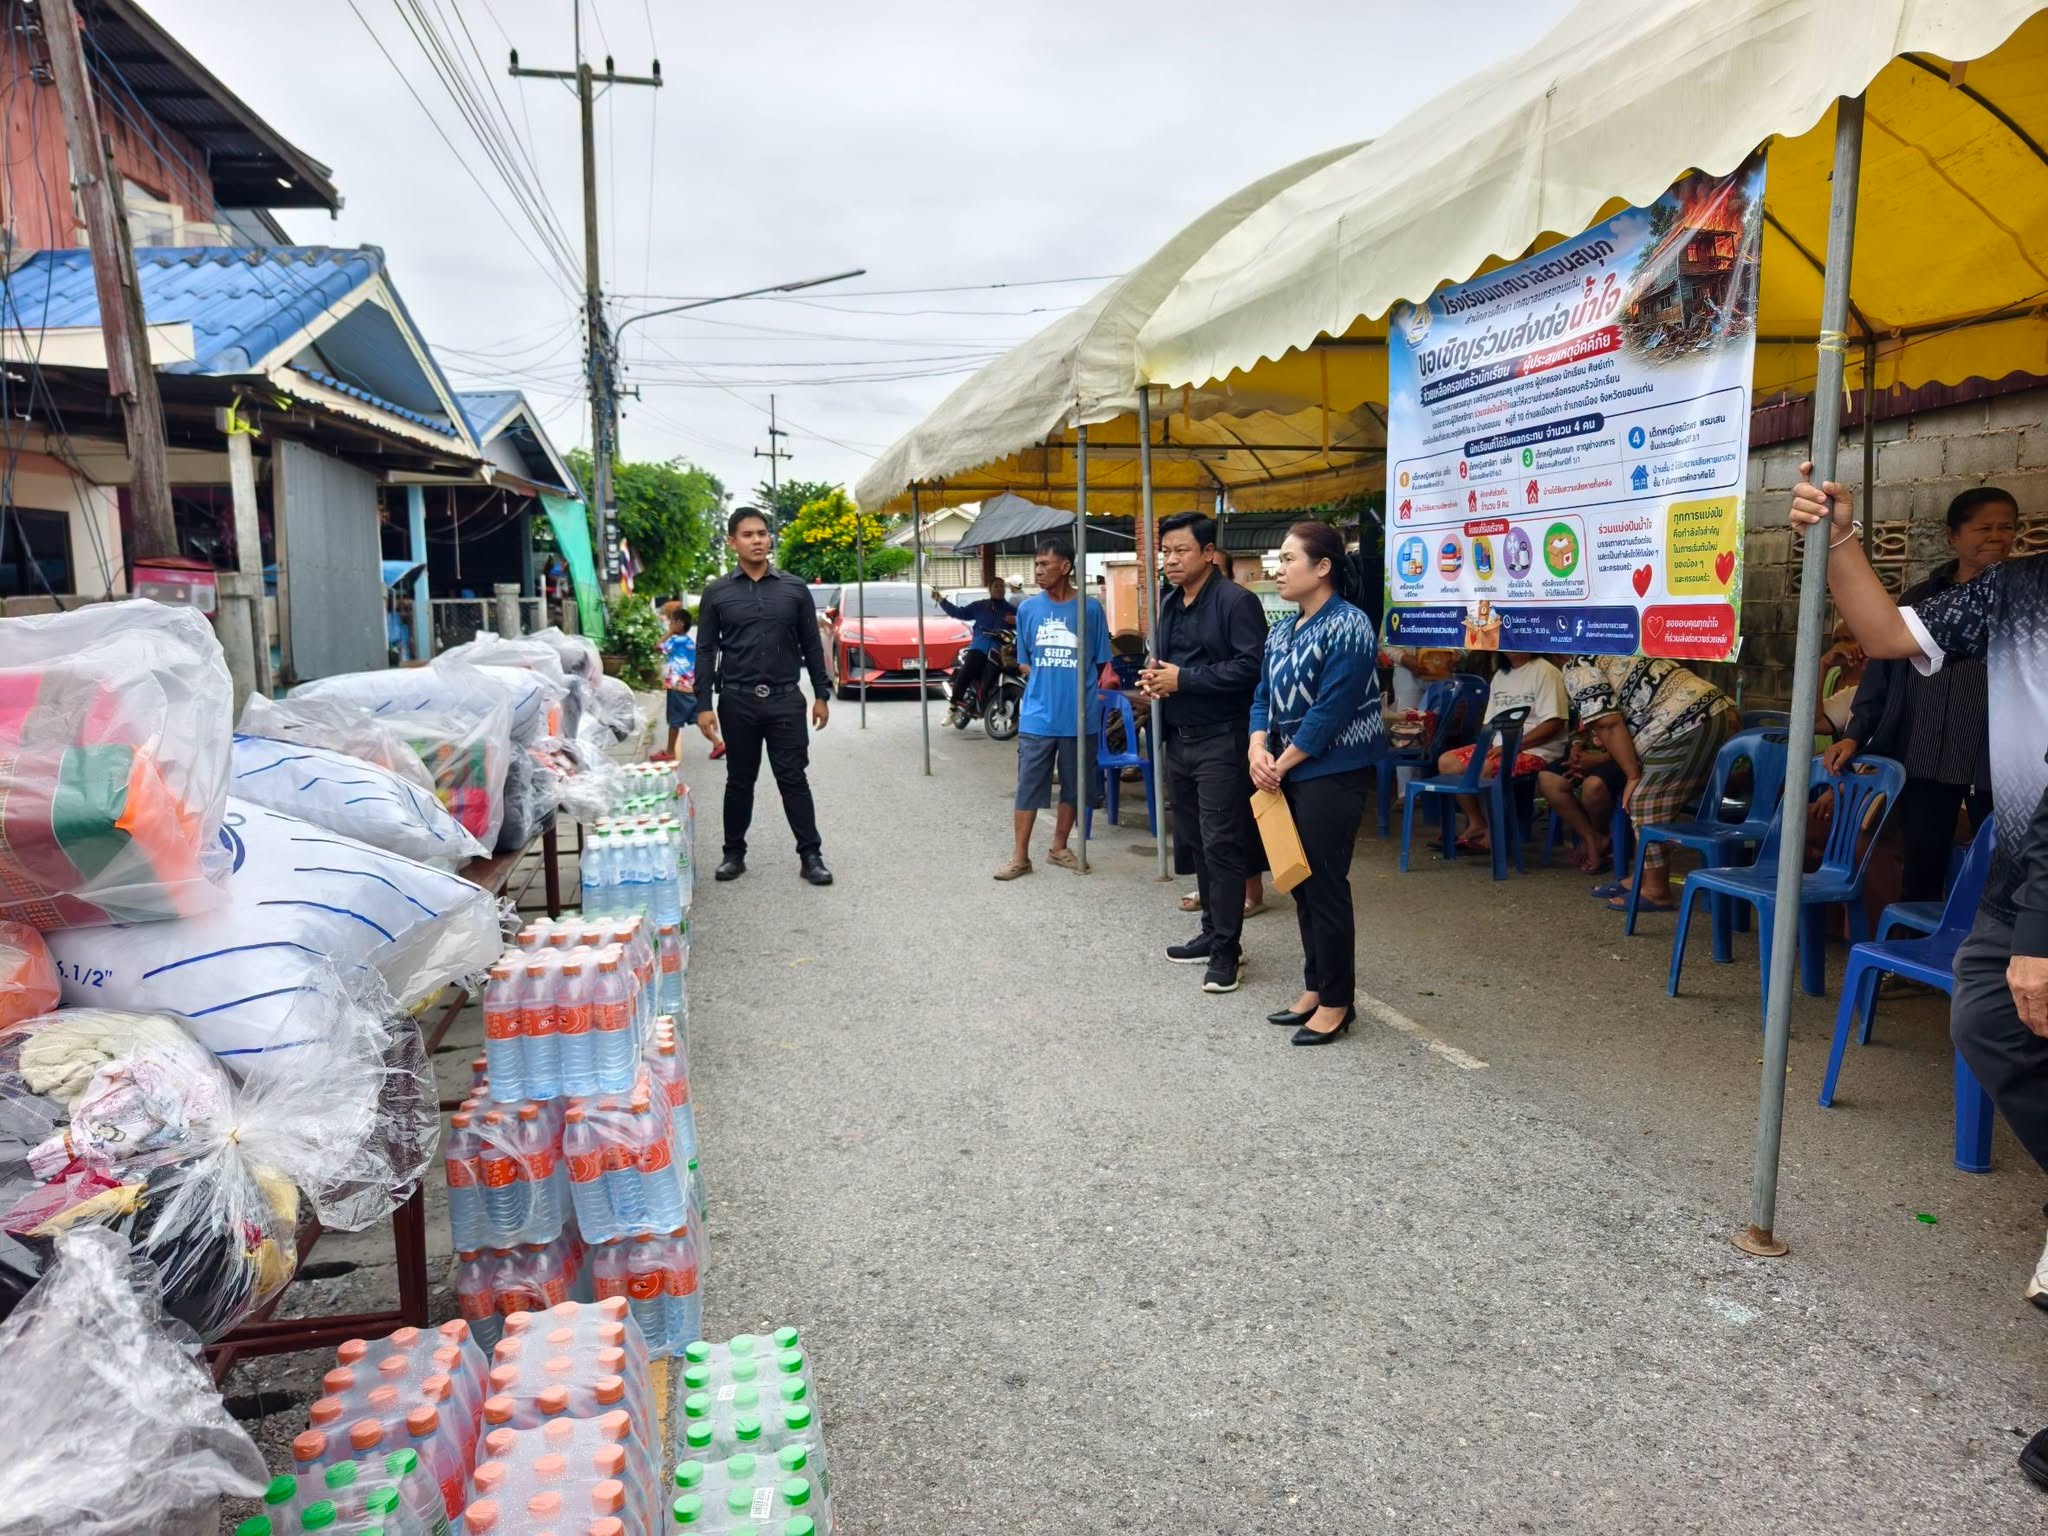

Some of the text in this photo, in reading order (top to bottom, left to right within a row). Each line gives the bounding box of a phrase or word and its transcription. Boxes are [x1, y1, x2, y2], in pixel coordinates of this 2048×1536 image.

[1440, 239, 1615, 317] โรงเรียนเทศบาลสวนสนุก
[1423, 334, 1611, 403] ช่วยเหลือครอบครัวนักเรียน ผู้ประสบเหตุอัคคีภัย
[1535, 373, 1561, 392] ผู้ปกครอง
[1563, 367, 1586, 380] นักเรียน
[1588, 357, 1614, 374] ศิษย์เก่า
[1517, 413, 1524, 422] 10
[1564, 395, 1598, 412] อำเภอเมือง
[1600, 383, 1654, 403] จังหวัดขอนแก่น
[1470, 420, 1596, 454] นักเรียนที่ได้รับผลกระทบ จำนวน 4 คน
[1598, 515, 1653, 535] ร่วมแบ่งปันน้ำใจ
[1673, 506, 1723, 526] ทุกการแบ่งปัน
[1673, 526, 1720, 540] คือกำลังใจสำคัญ
[1673, 540, 1718, 555] ในการเริ่มต้นใหม่
[1044, 648, 1072, 658] SHIP
